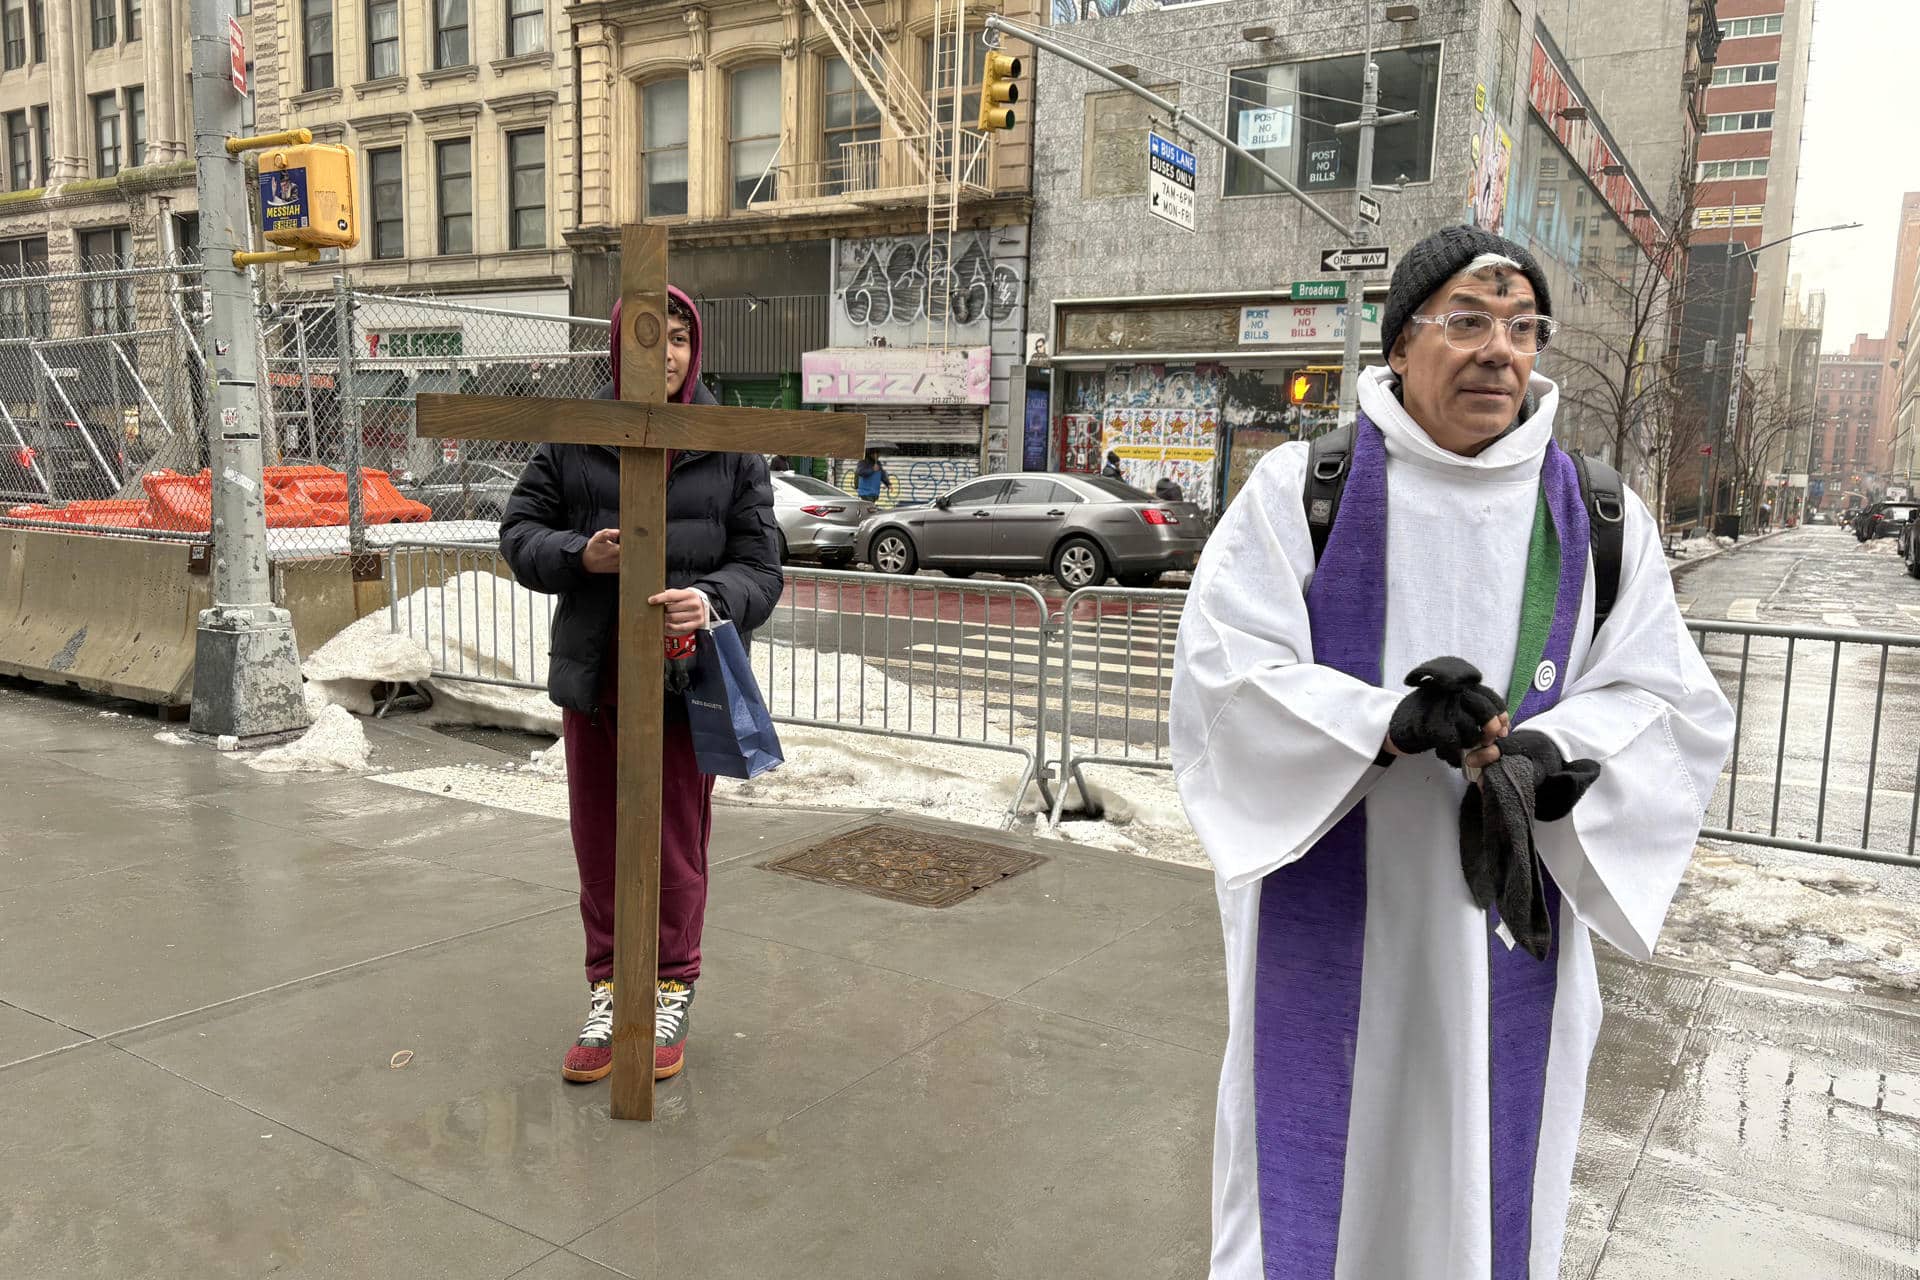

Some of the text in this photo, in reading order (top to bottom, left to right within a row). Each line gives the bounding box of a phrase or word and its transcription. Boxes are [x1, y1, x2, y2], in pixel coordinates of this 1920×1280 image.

[1254, 112, 1277, 122] POST
[1258, 124, 1271, 133] NO
[1252, 135, 1277, 145] BILLS
[1161, 142, 1194, 171] BUS LANE
[1312, 150, 1336, 160] POST
[1316, 162, 1330, 170] NO
[1152, 156, 1194, 188] BUSES ONLY
[1310, 172, 1335, 182] BILLS
[1162, 182, 1193, 208] 7AM-6PM
[266, 205, 300, 218] MESSIAH
[1163, 199, 1193, 224] MON-FRI
[1333, 254, 1382, 265] ONE WAY
[1299, 284, 1340, 298] Broadway
[1246, 310, 1269, 319] POST
[1293, 308, 1317, 317] POST
[1251, 320, 1263, 329] NO
[1298, 318, 1311, 327] NO
[1244, 331, 1269, 340] BILLS
[1291, 328, 1317, 337] BILLS
